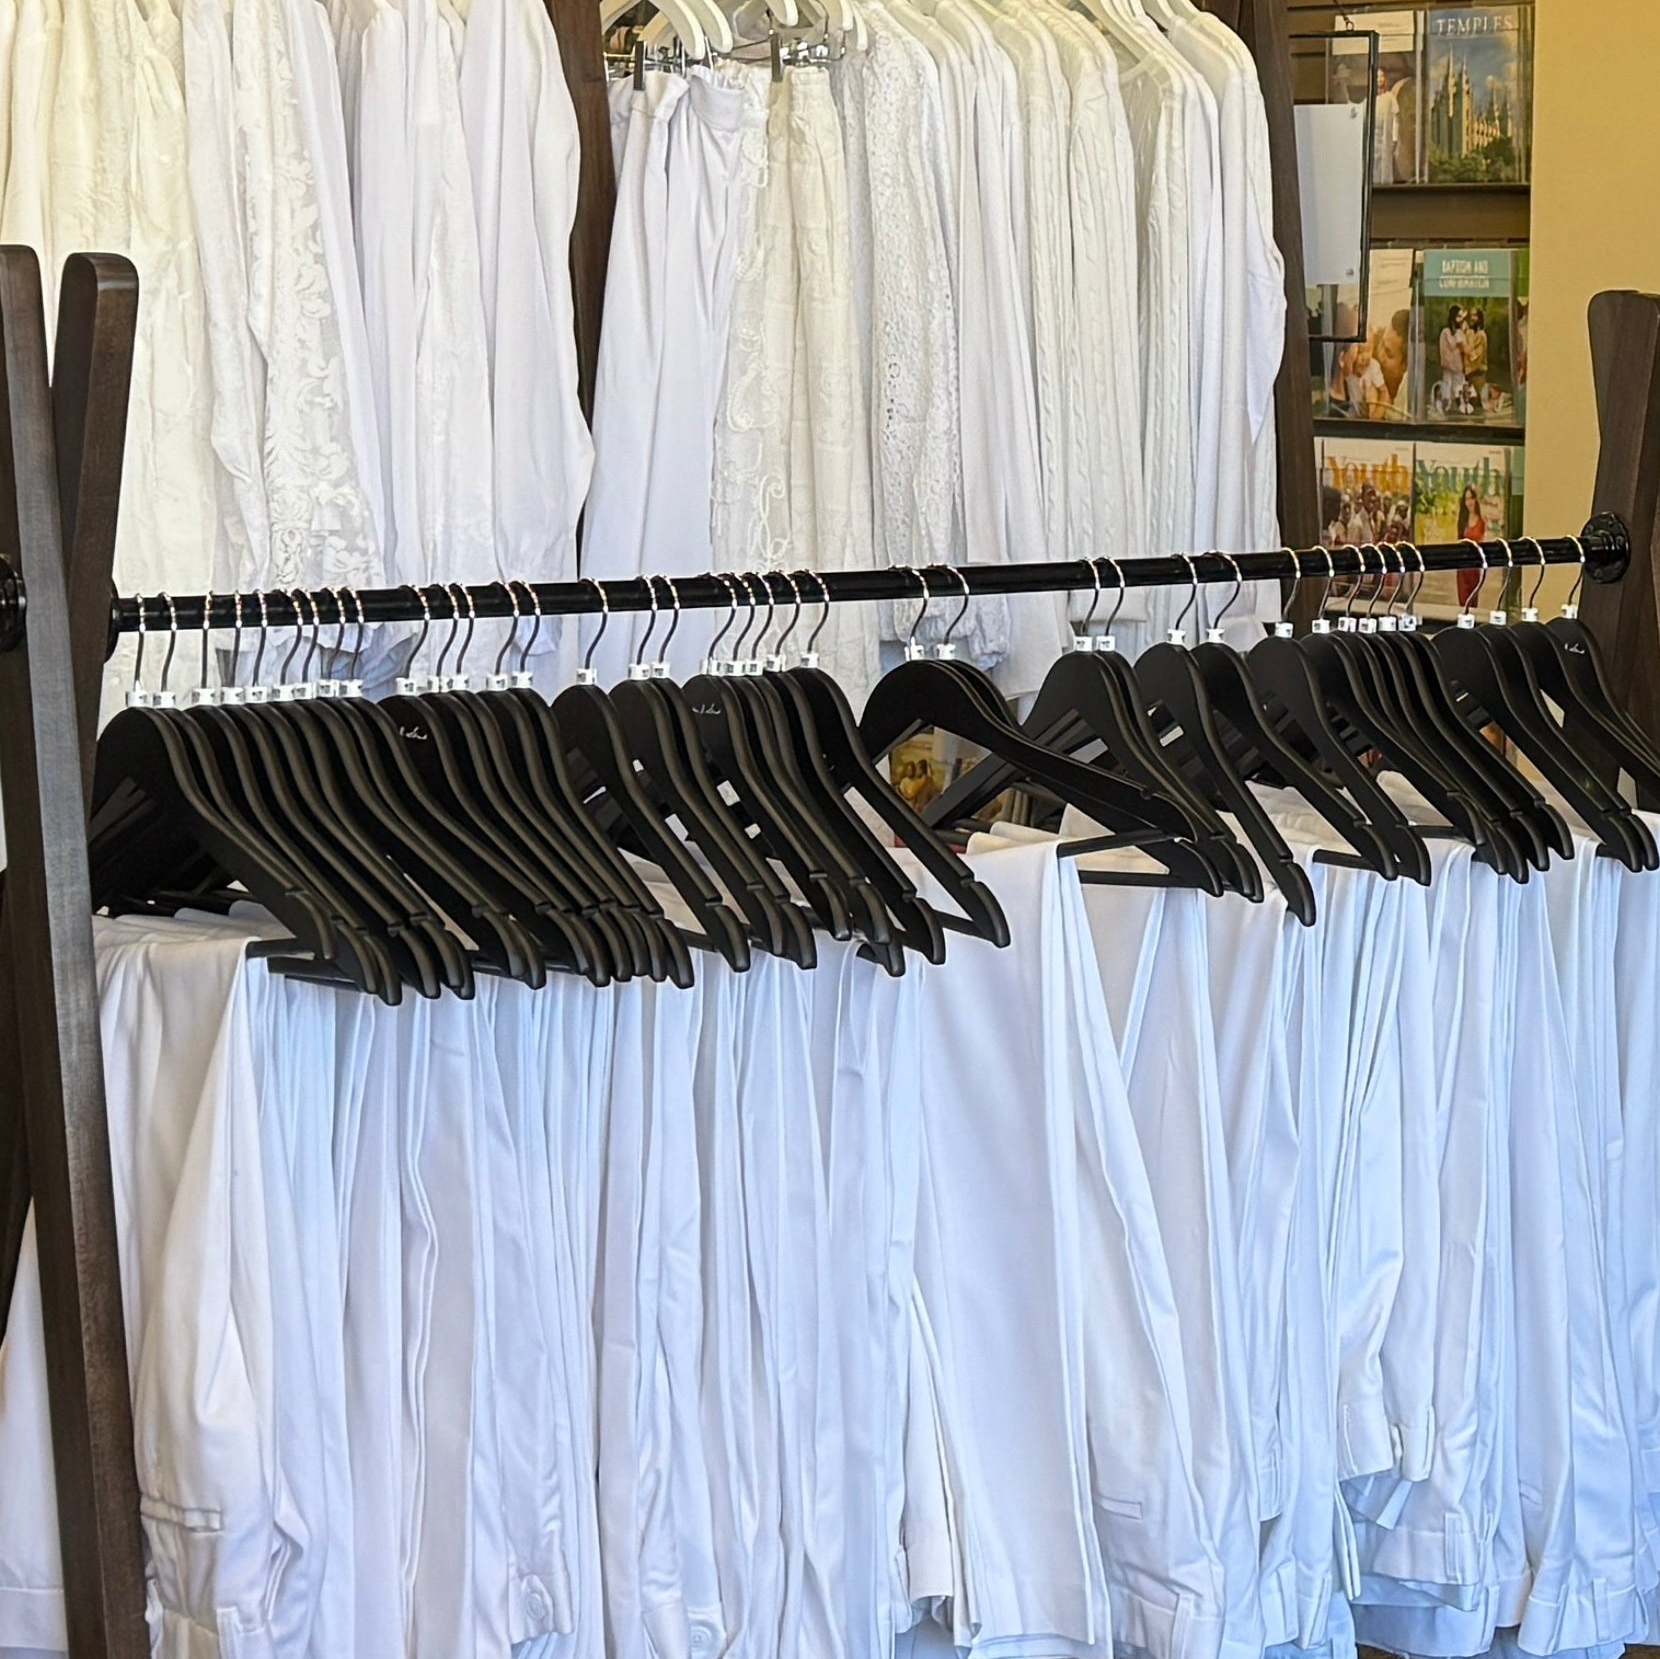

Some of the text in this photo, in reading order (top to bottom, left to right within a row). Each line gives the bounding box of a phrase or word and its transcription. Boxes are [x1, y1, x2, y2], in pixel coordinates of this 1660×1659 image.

[1436, 15, 1512, 35] TEMPLES
[1328, 454, 1409, 494] Youth
[1417, 457, 1502, 497] Youth
